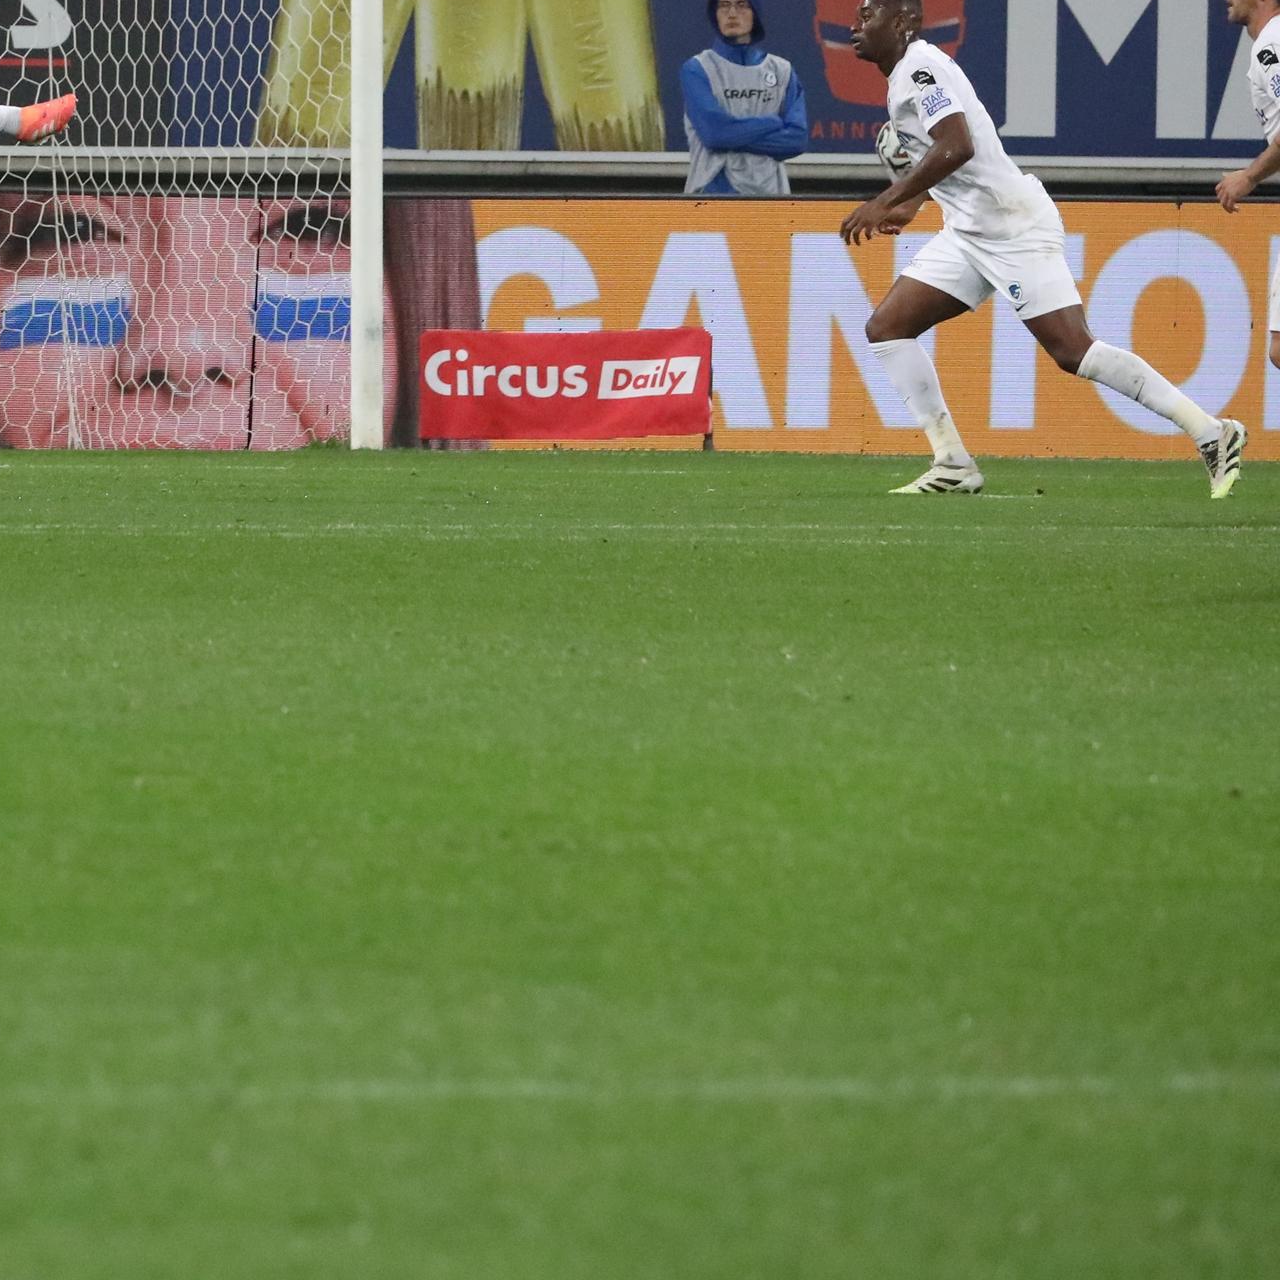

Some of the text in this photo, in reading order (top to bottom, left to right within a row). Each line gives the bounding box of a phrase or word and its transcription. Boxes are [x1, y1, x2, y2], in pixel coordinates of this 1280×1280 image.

[724, 88, 763, 101] CRAFT
[477, 226, 1280, 436] GANTO
[424, 349, 688, 398] Circus Daily
